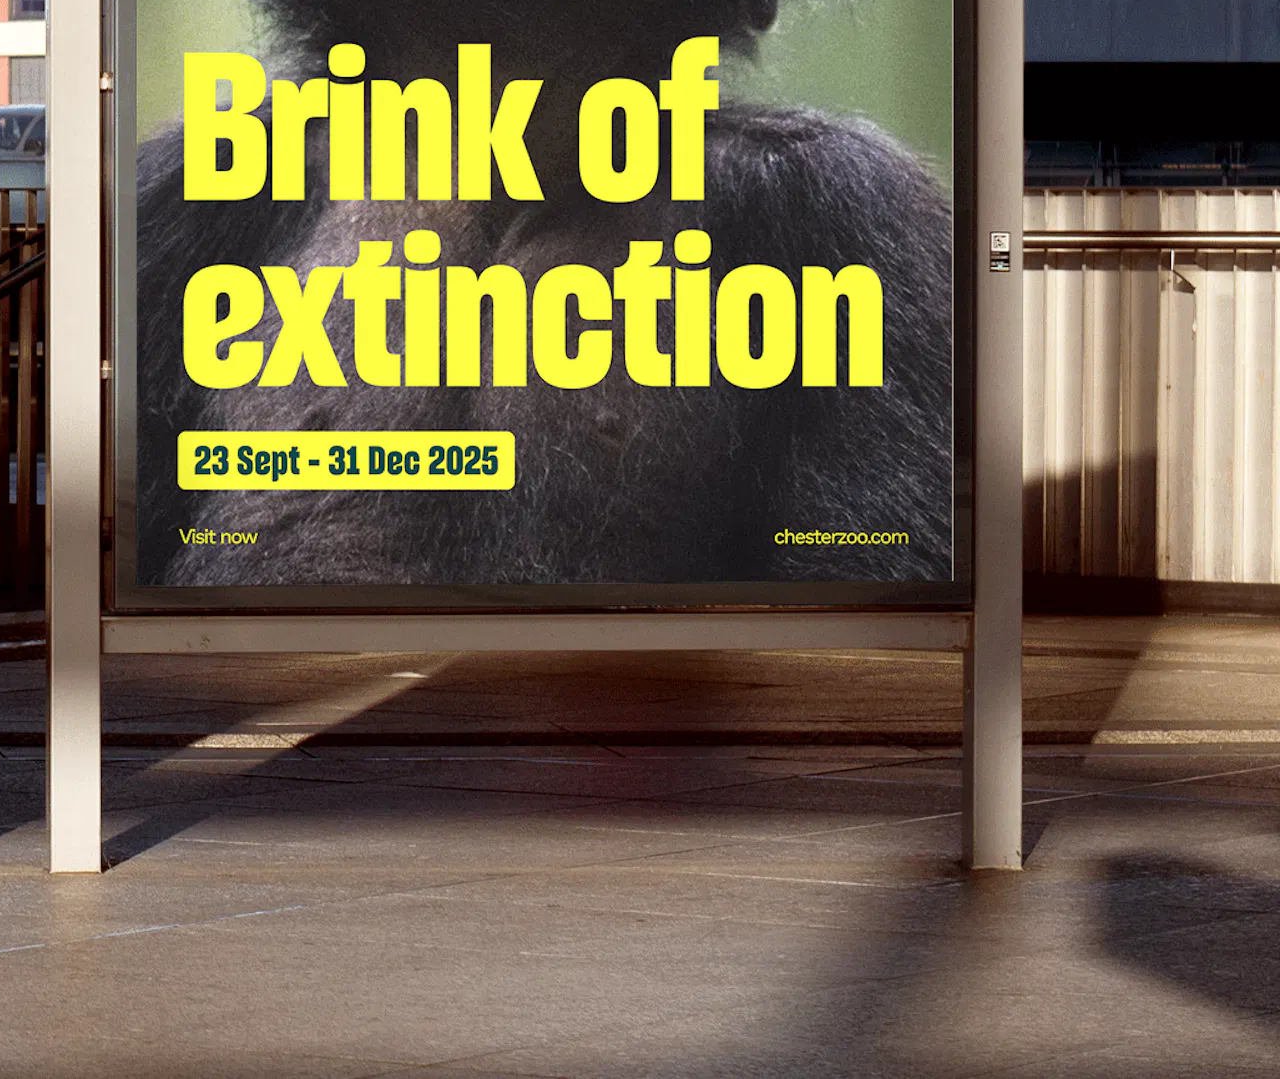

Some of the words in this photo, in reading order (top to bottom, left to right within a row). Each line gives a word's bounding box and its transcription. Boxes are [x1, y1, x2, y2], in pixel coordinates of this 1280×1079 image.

[183, 43, 545, 204] Brink
[578, 37, 720, 204] of
[183, 229, 883, 390] extinction
[194, 445, 229, 476] 23
[237, 445, 300, 483] Sept
[328, 445, 360, 476] 31
[368, 445, 420, 476] Dec
[428, 445, 499, 476] 2025
[179, 528, 217, 545] Visit
[220, 532, 259, 545] now
[774, 528, 909, 545] chesterzoo.com
